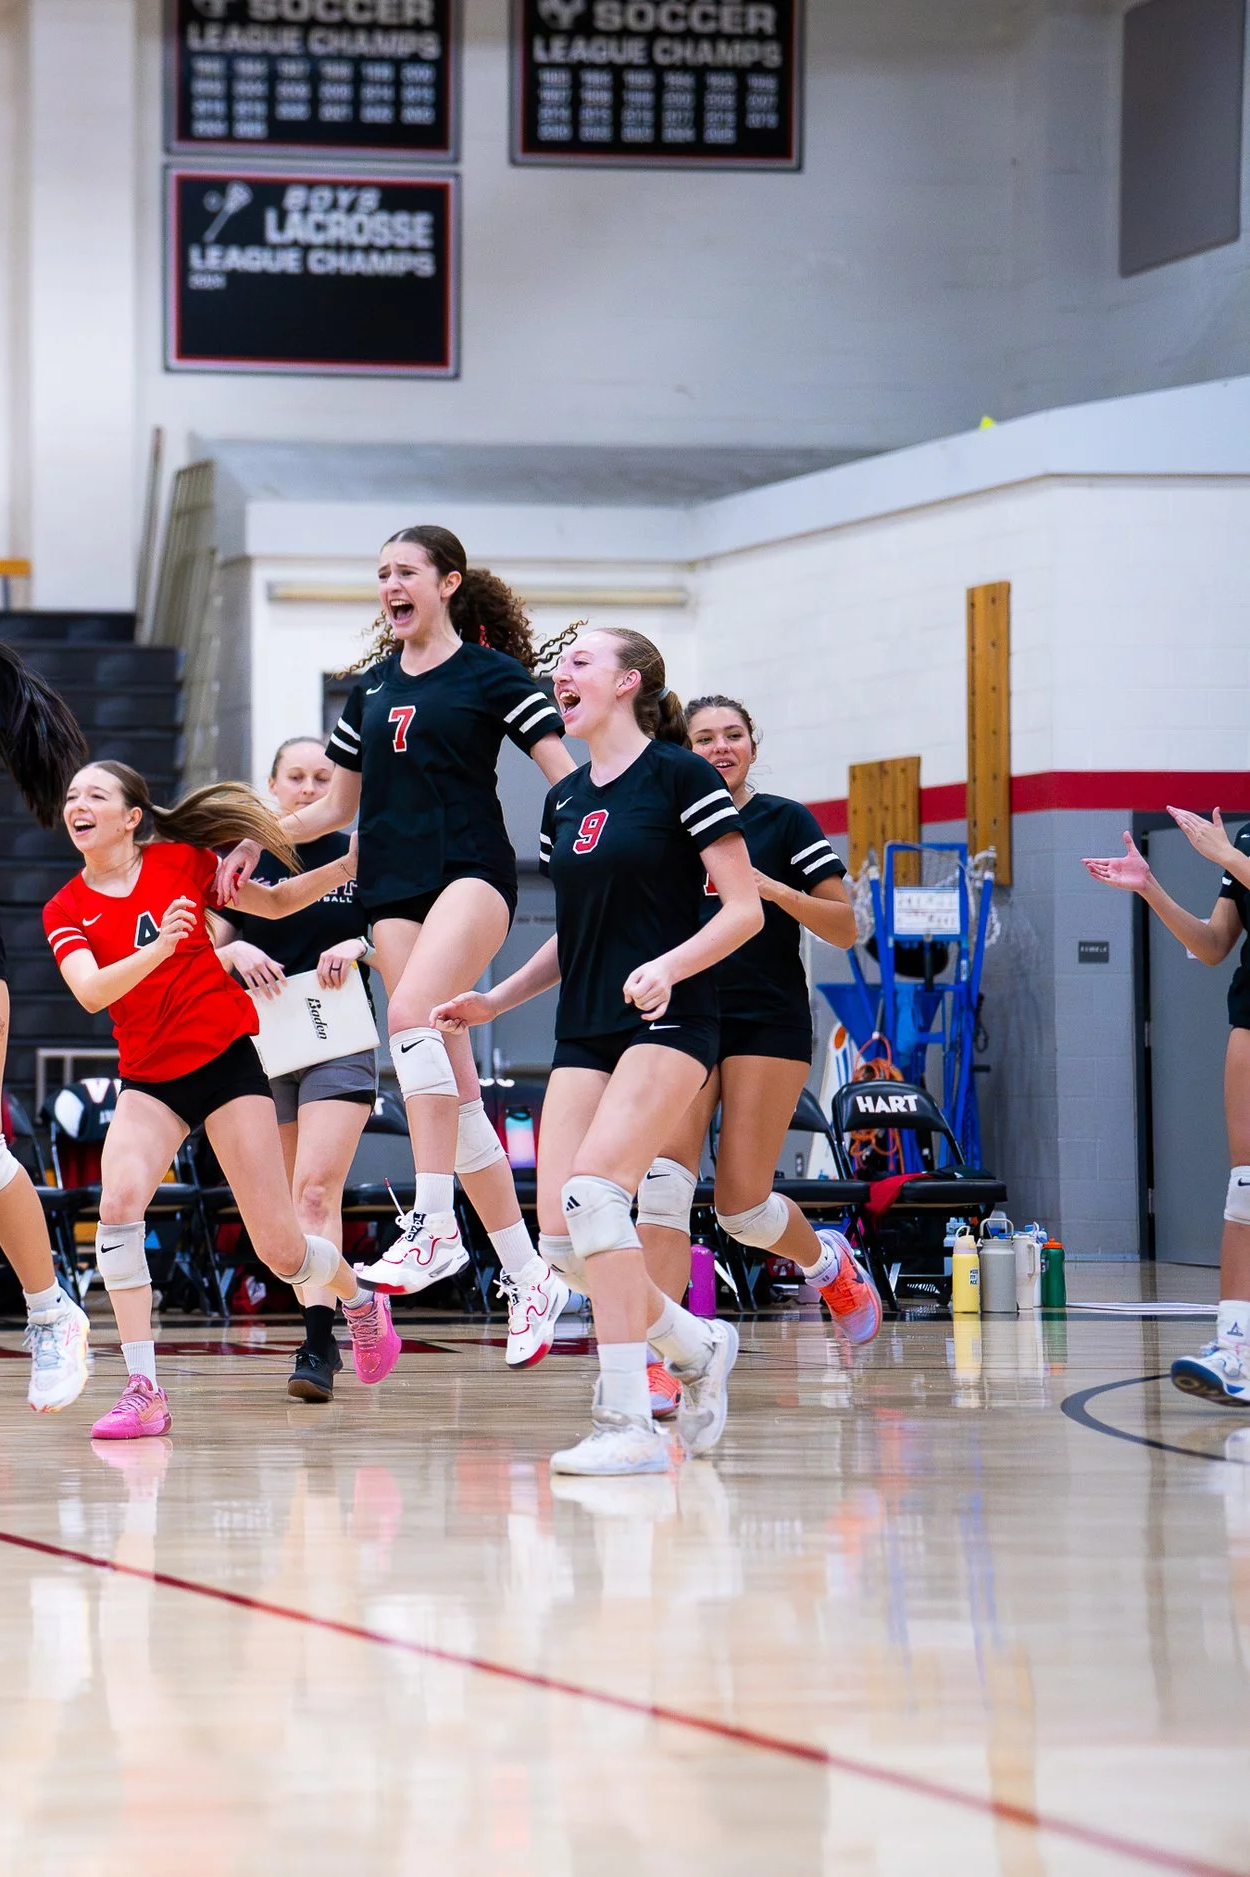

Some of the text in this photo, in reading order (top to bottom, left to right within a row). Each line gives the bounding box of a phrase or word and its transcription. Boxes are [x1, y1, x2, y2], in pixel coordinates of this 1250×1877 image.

[593, 1, 776, 35] SOCCER
[187, 23, 440, 59] LEAGUE CHAMPS
[533, 35, 782, 68] LEAGUE CHAMPS
[283, 185, 381, 212] BOYS
[265, 207, 434, 248] LACROSSE
[189, 245, 435, 277] LEAGUE CHAMPS
[388, 705, 416, 753] 7
[572, 808, 609, 855] 9
[307, 998, 328, 1040] Baden
[856, 1095, 918, 1113] HART
